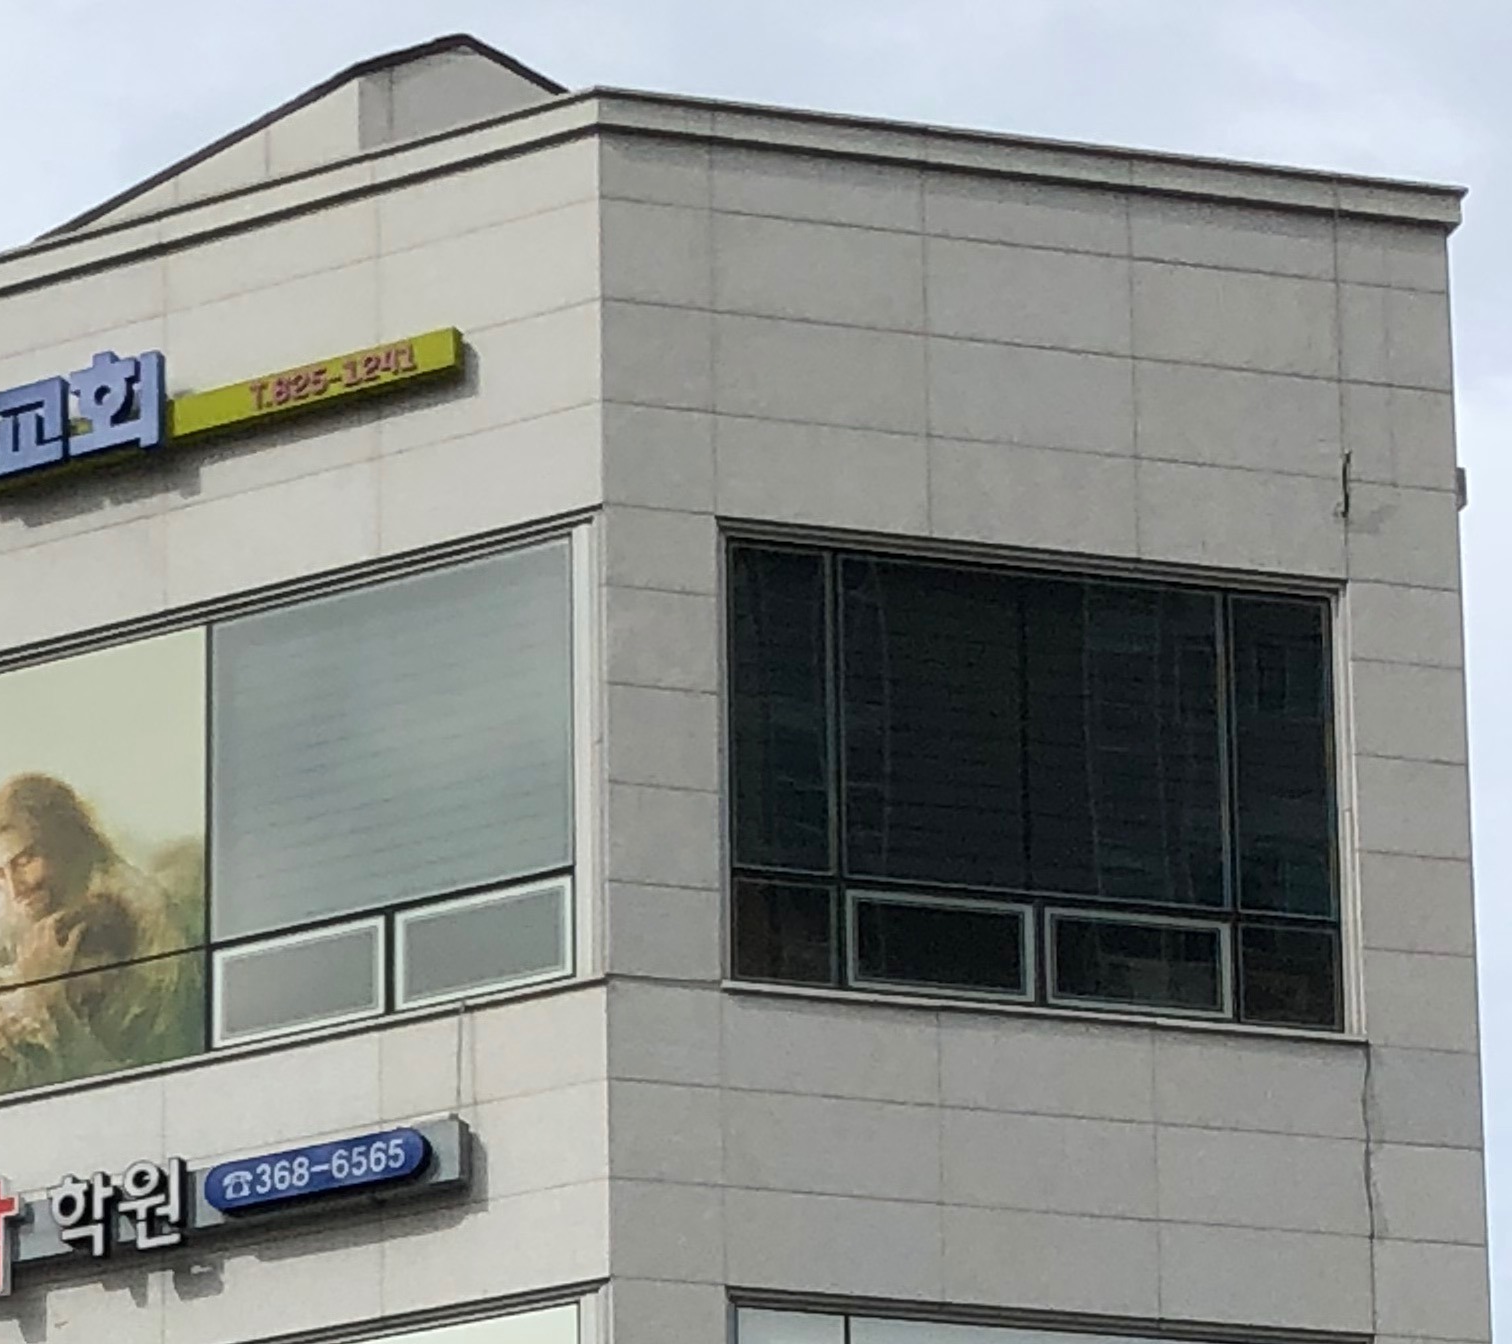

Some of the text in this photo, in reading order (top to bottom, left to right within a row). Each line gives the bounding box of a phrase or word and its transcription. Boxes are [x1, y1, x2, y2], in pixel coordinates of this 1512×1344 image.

[250, 347, 417, 410] T.825-1241
[50, 1157, 186, 1256] 학원
[255, 1138, 406, 1192] 368-6565
